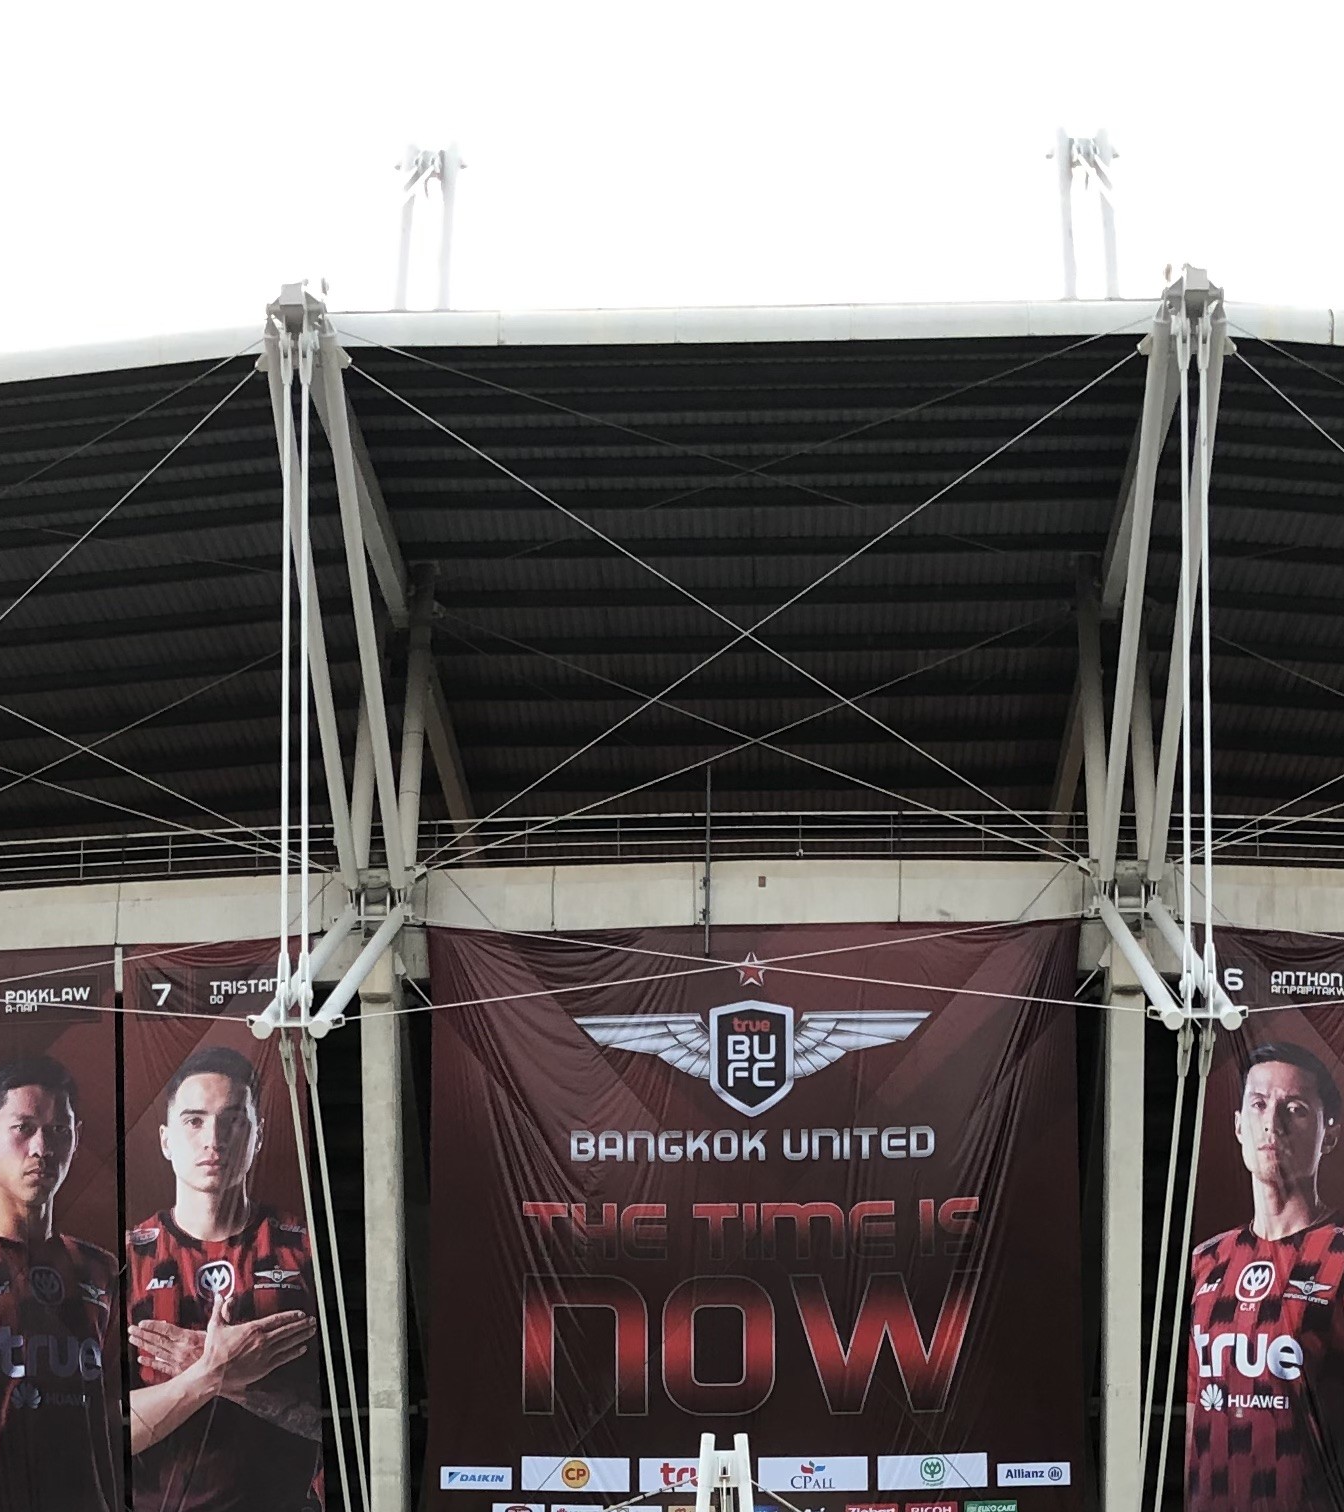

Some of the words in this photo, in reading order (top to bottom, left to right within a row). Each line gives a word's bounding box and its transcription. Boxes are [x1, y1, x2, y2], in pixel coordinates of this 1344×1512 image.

[210, 978, 278, 995] TRISTAN
[1224, 968, 1244, 991] 6
[152, 983, 171, 1006] 7
[210, 995, 224, 1004] DO
[733, 1017, 770, 1033] true
[727, 1035, 776, 1061] BU
[727, 1062, 776, 1088] FC
[570, 1130, 767, 1163] BANGKOK
[783, 1125, 935, 1161] UNITED
[522, 1201, 668, 1261] THE
[692, 1200, 895, 1260] TIME
[918, 1196, 980, 1258] IS
[145, 1275, 176, 1291] Ari
[522, 1273, 981, 1417] NOW
[1194, 1324, 1303, 1380] true
[1228, 1394, 1289, 1409] HUAWEI
[460, 1472, 505, 1483] DAIKIN
[565, 1468, 586, 1481] CP
[660, 1462, 700, 1486] tru
[1006, 1467, 1044, 1479] Allianz
